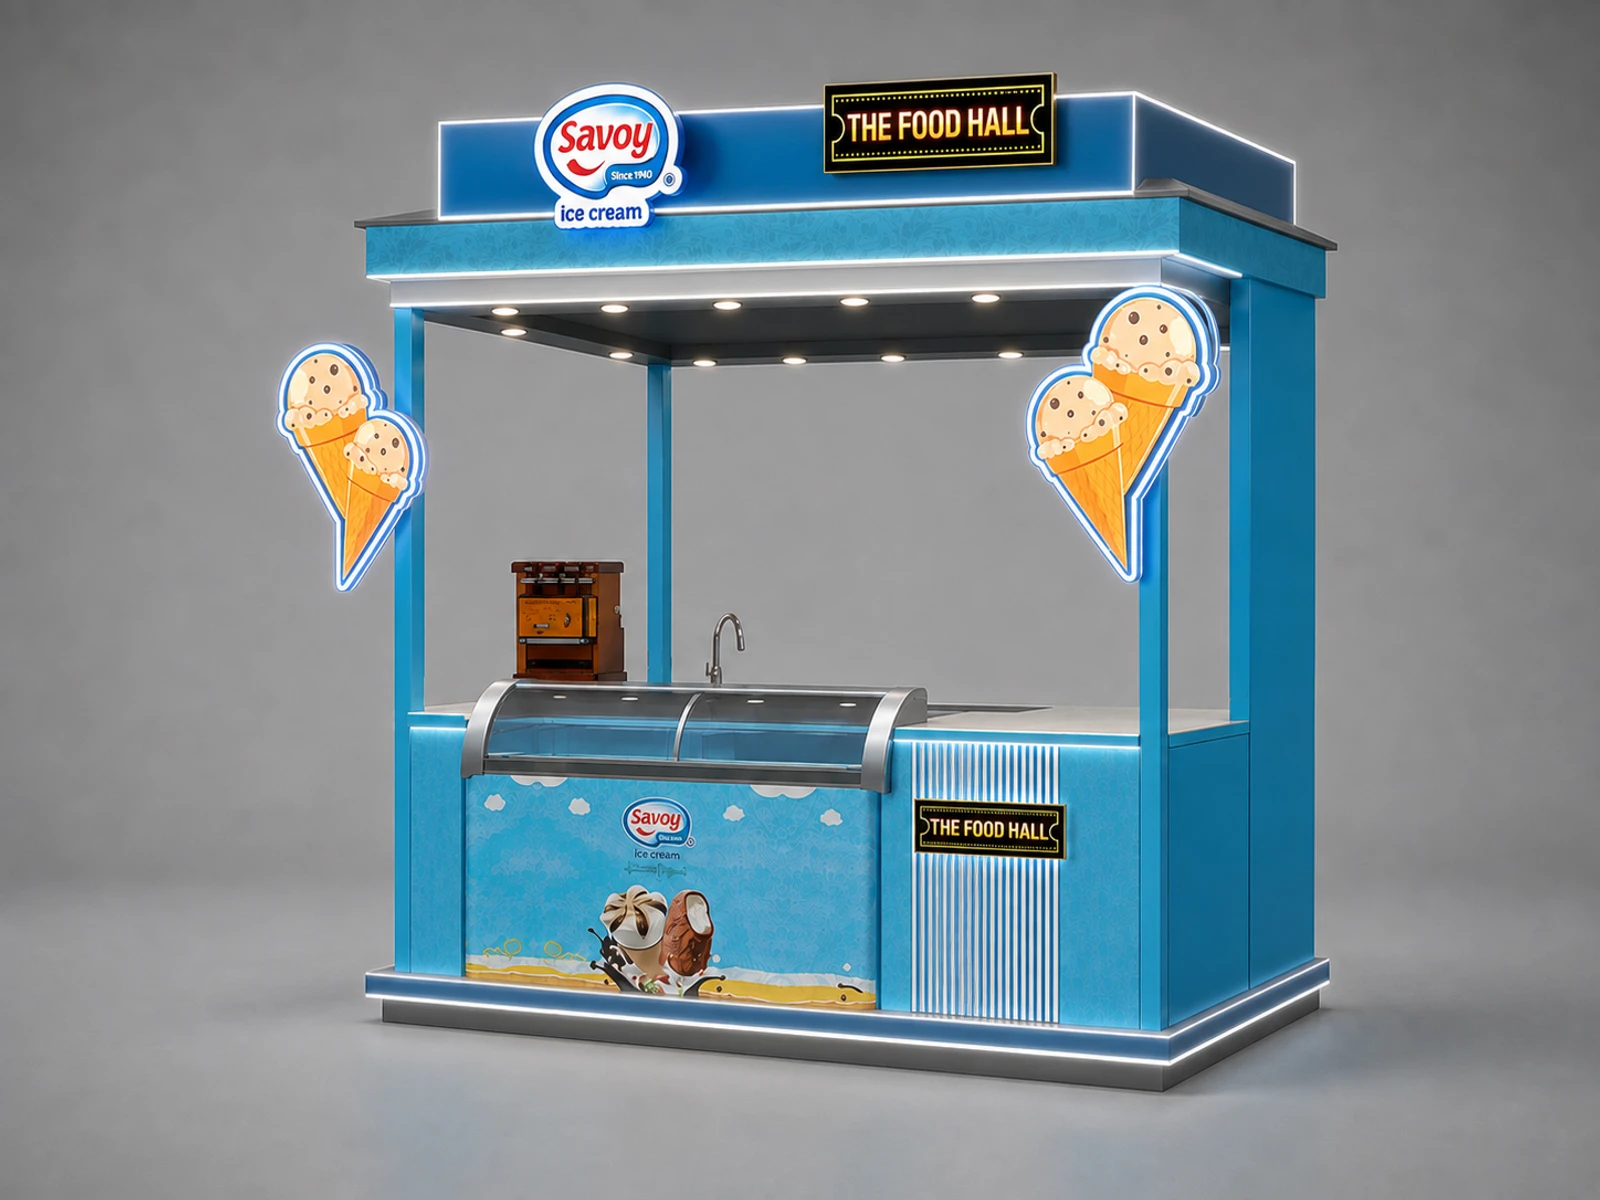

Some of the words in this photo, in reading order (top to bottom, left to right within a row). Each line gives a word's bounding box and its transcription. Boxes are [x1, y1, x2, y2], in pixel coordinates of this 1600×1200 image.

[847, 112, 892, 142] THE
[898, 109, 961, 140] FOOD
[967, 106, 1030, 137] HALL
[558, 120, 653, 159] Savoy
[611, 171, 633, 180] Since
[634, 170, 653, 179] 1940
[560, 205, 584, 222] ice
[588, 206, 642, 221] cream
[631, 808, 681, 831] Savoy
[929, 818, 960, 836] THE
[964, 820, 1005, 838] FOOD
[1008, 822, 1049, 840] HALL
[634, 849, 648, 859] ice
[650, 851, 681, 860] cream
